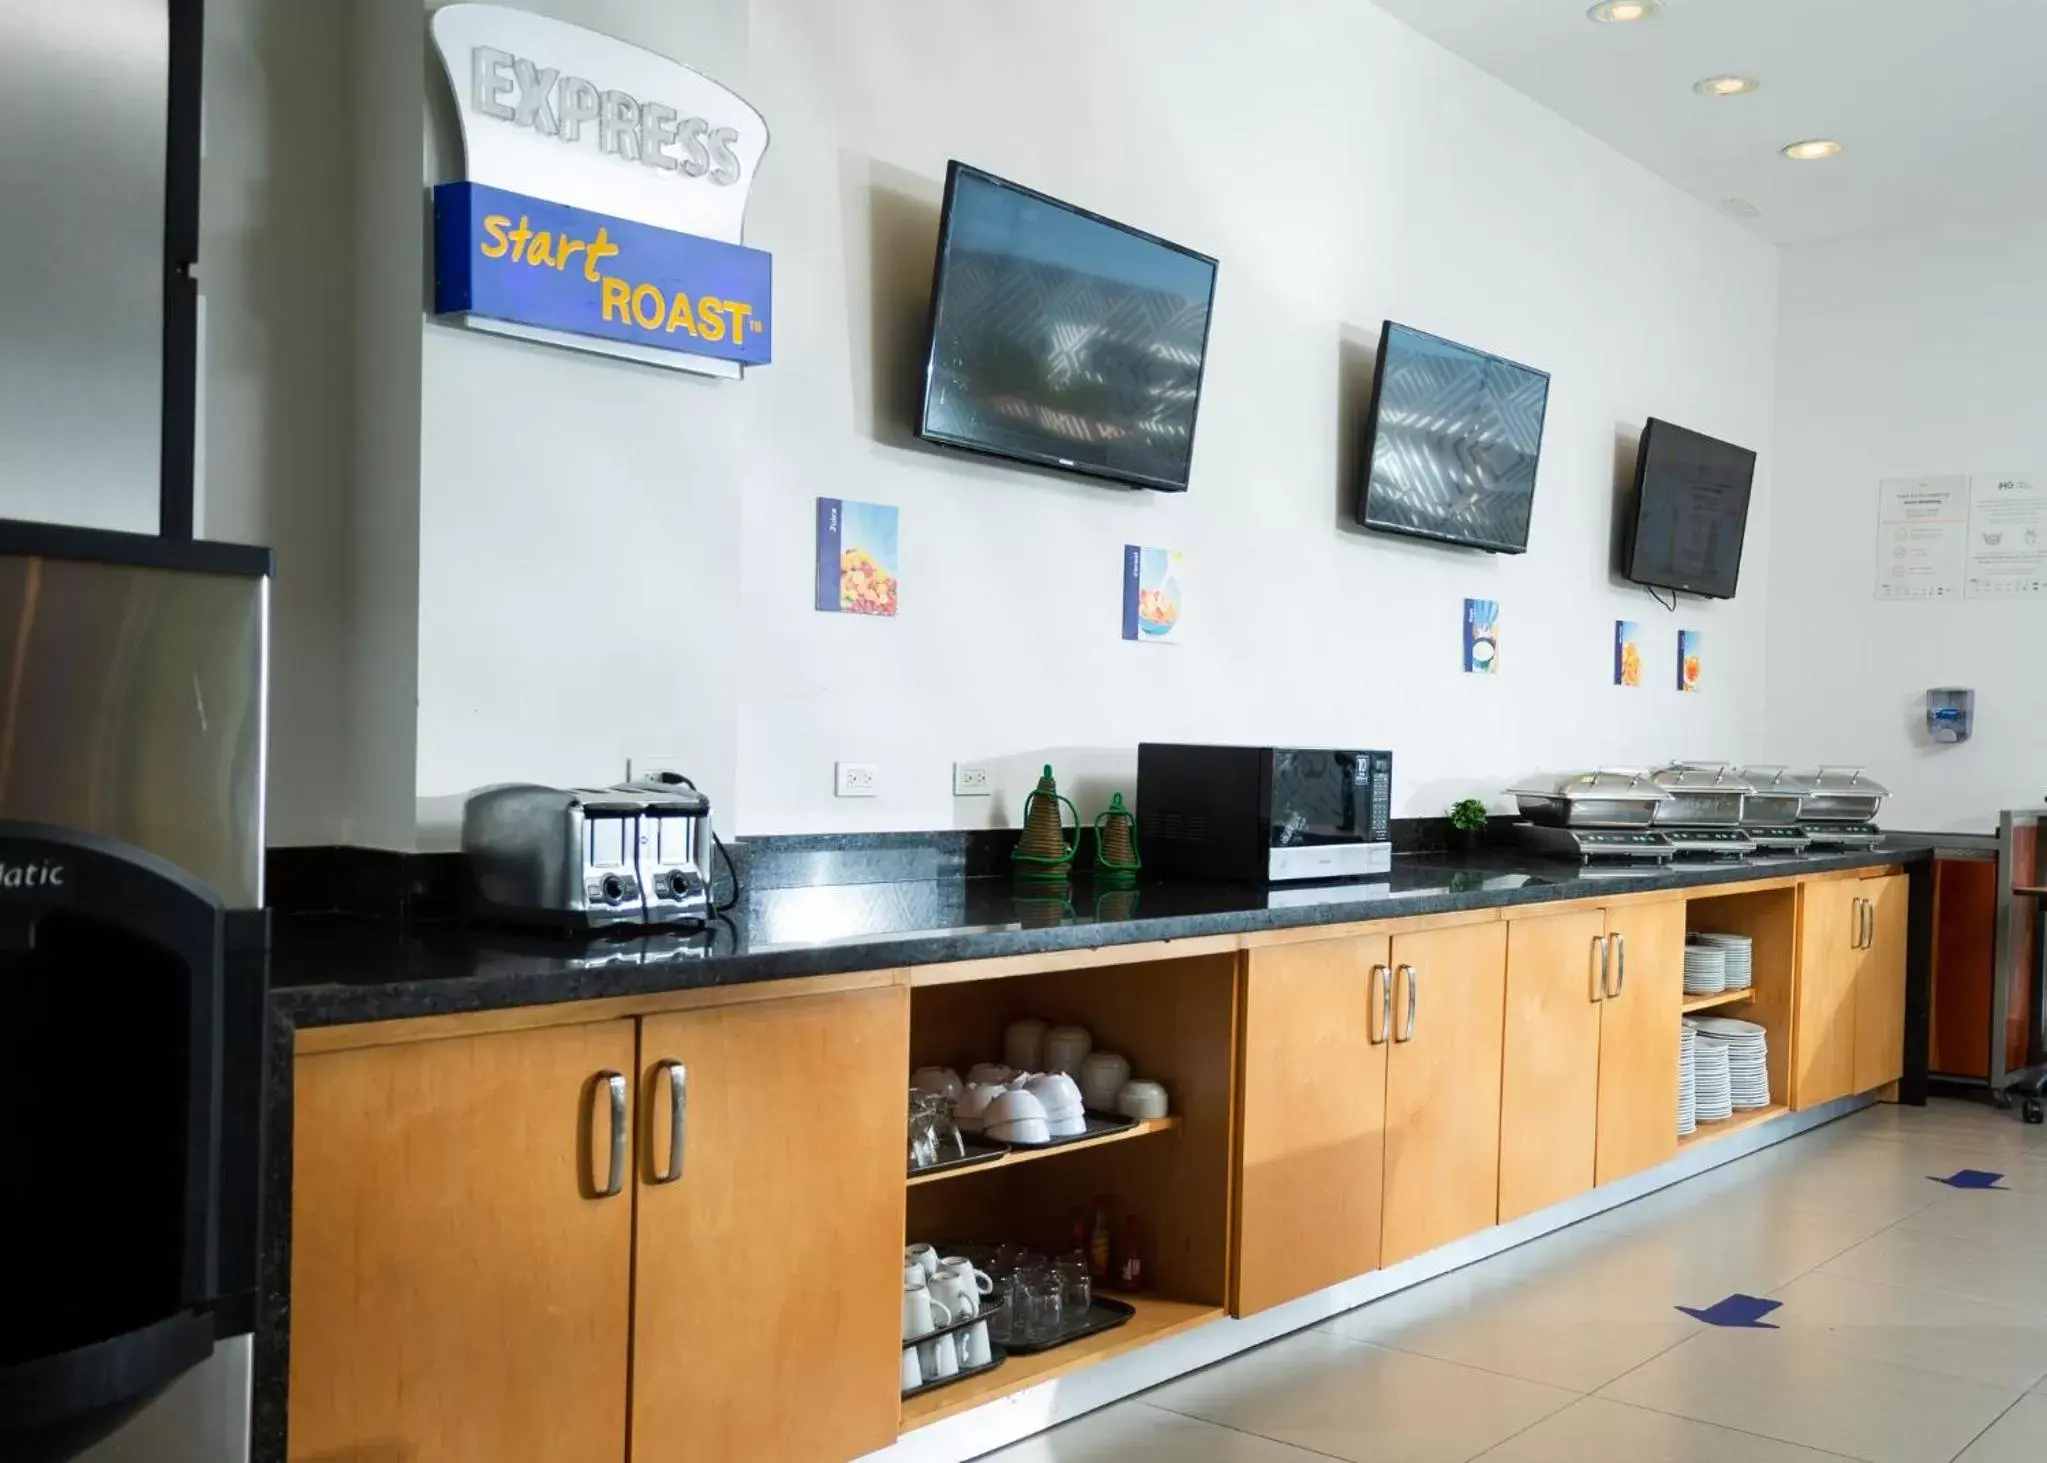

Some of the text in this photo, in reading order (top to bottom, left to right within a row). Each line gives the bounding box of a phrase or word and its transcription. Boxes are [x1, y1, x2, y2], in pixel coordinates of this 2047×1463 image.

[472, 46, 741, 185] EXPRESS
[480, 214, 620, 282] Start
[602, 278, 752, 345] ROAST
[0, 857, 64, 888] atic
